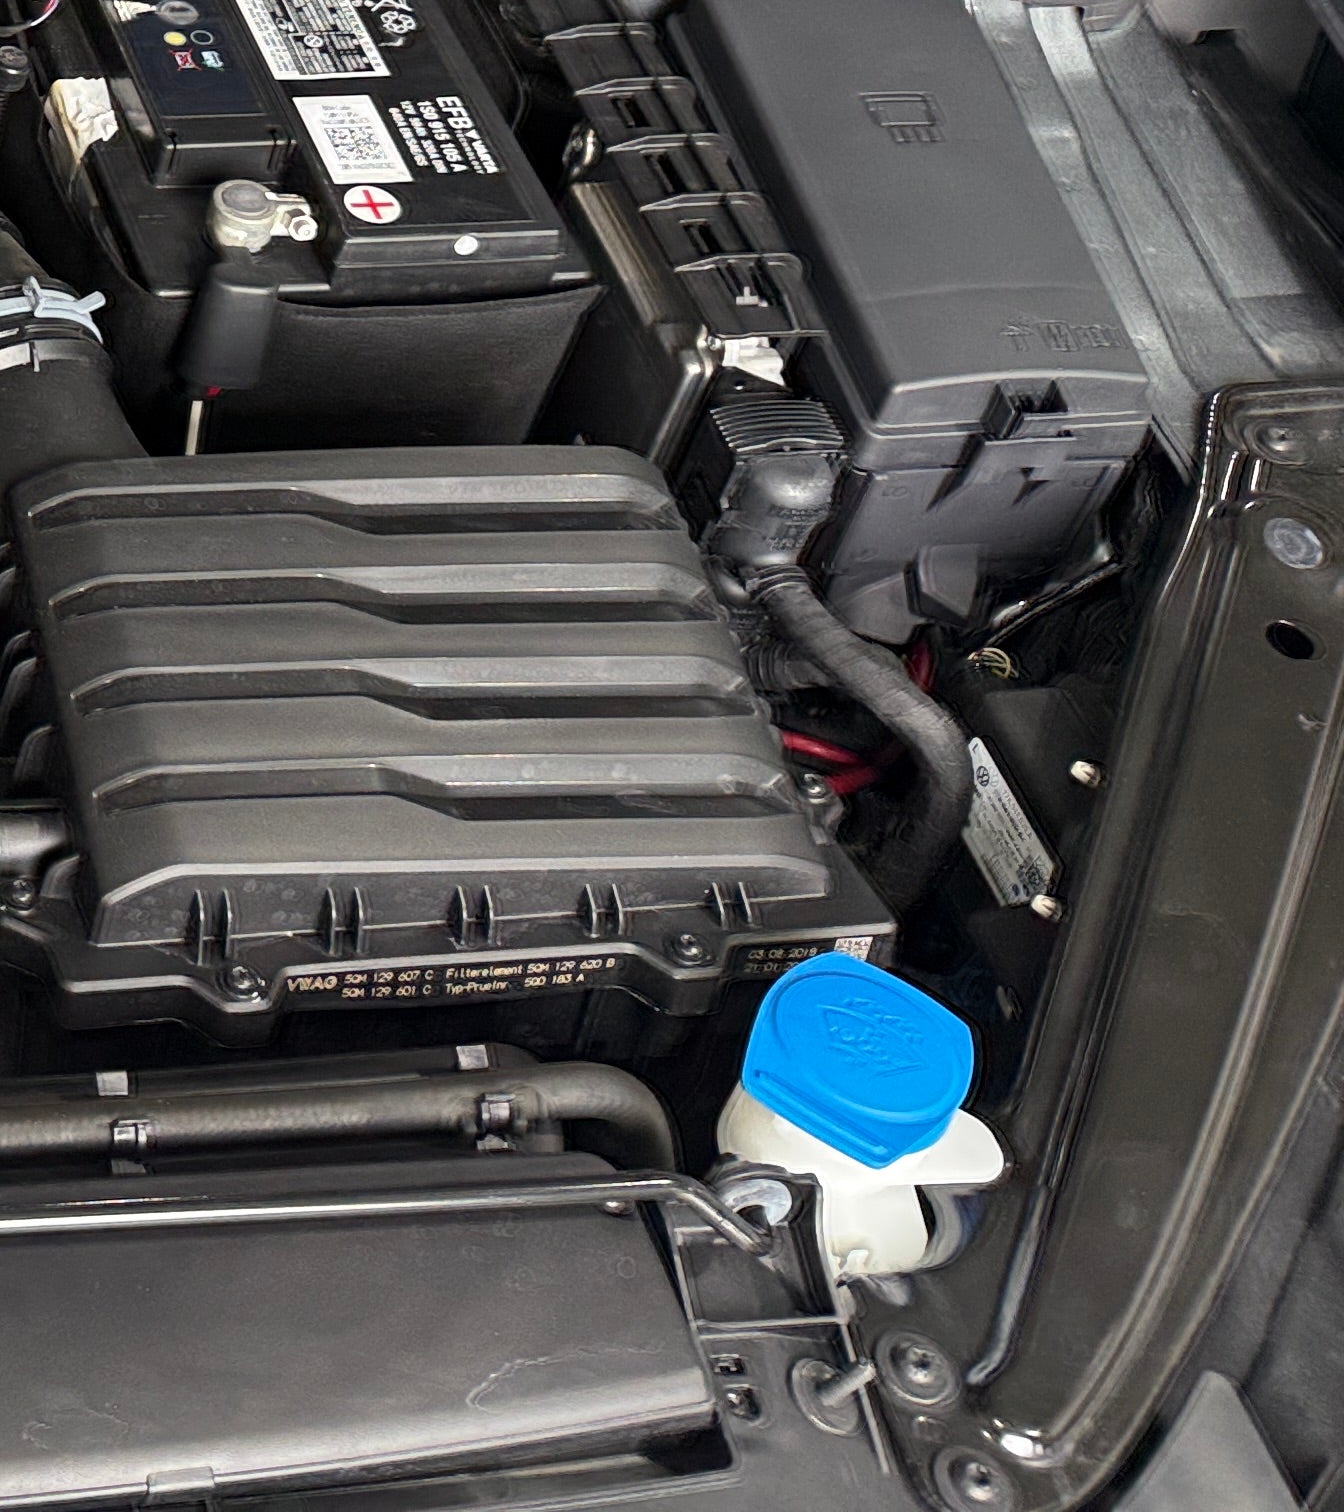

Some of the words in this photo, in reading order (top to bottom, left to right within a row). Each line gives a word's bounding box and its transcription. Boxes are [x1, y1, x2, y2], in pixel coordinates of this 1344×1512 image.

[427, 121, 451, 141] 915
[435, 96, 475, 129] EFB
[472, 139, 499, 174] VARTA
[439, 143, 463, 162] 105
[449, 163, 470, 173] A
[373, 971, 394, 983] 129
[397, 970, 421, 982] 607
[424, 969, 434, 980] C
[445, 964, 523, 980] Filterelement
[555, 961, 576, 972] 129
[605, 957, 616, 969] B
[287, 975, 338, 992] VWAG
[372, 986, 392, 997] 129
[396, 985, 416, 997] 601
[422, 984, 432, 995] C
[575, 972, 585, 982] A
